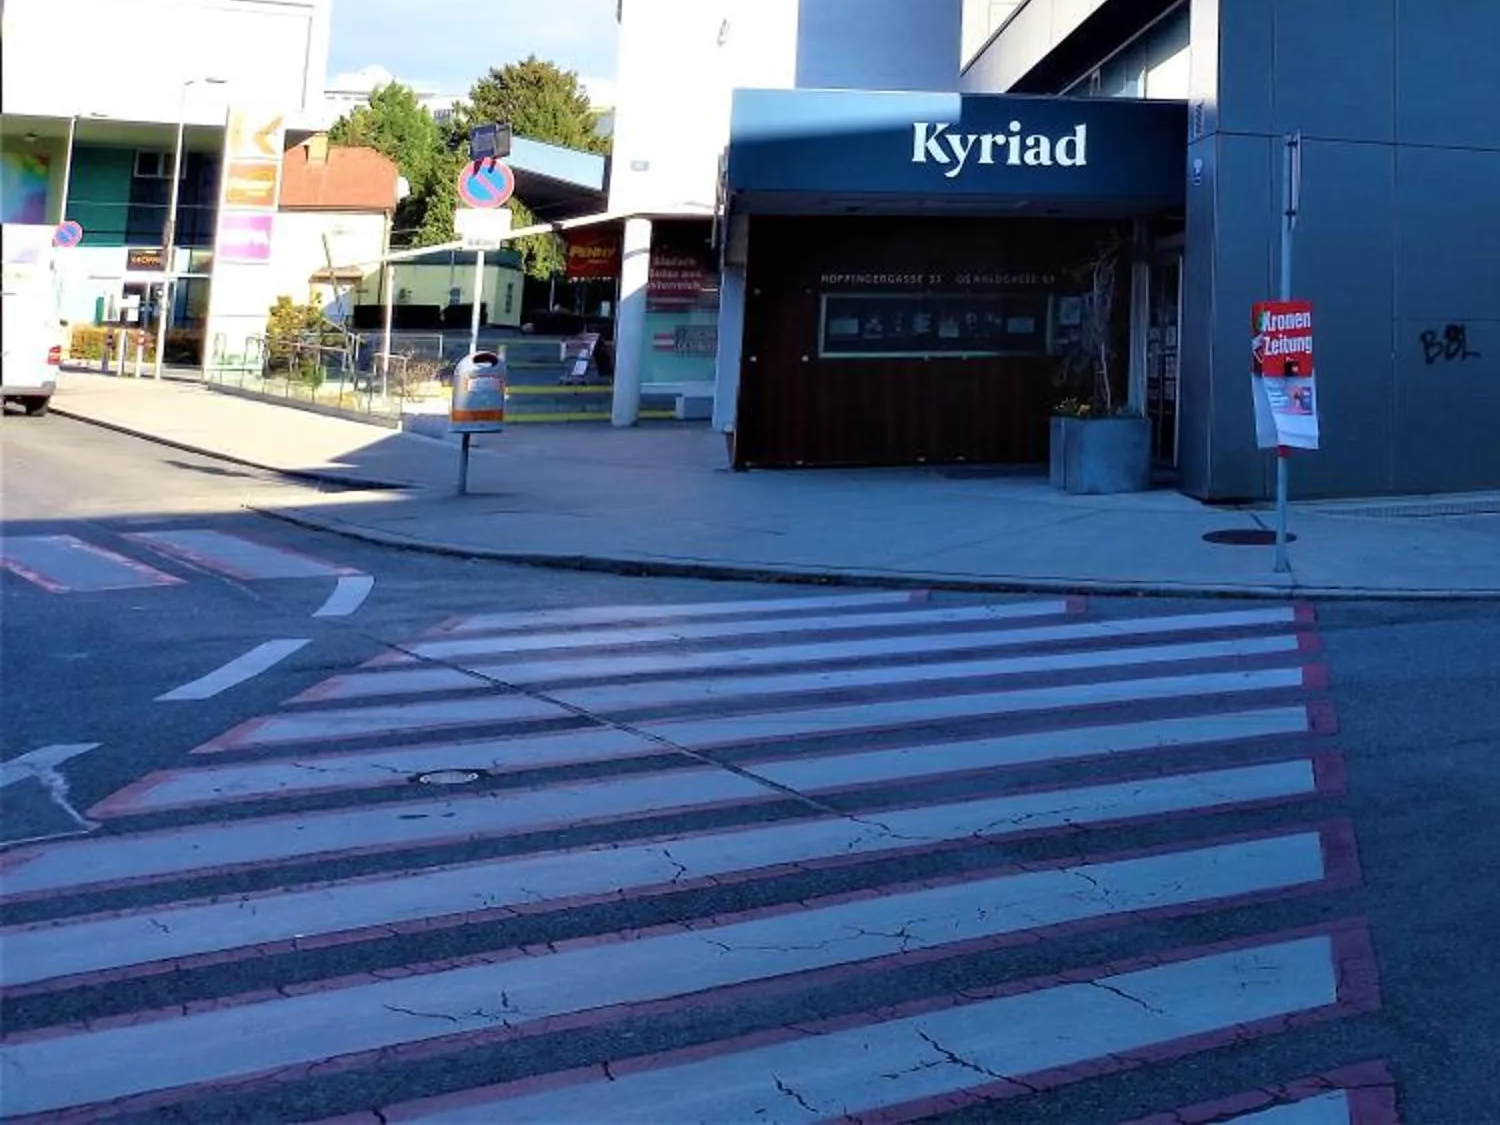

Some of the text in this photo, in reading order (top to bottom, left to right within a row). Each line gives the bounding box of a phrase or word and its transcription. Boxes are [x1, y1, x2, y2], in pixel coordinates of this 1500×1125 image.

[911, 120, 1088, 178] Kyriad
[1262, 311, 1311, 331] Kronen
[1263, 334, 1313, 355] Zeitung
